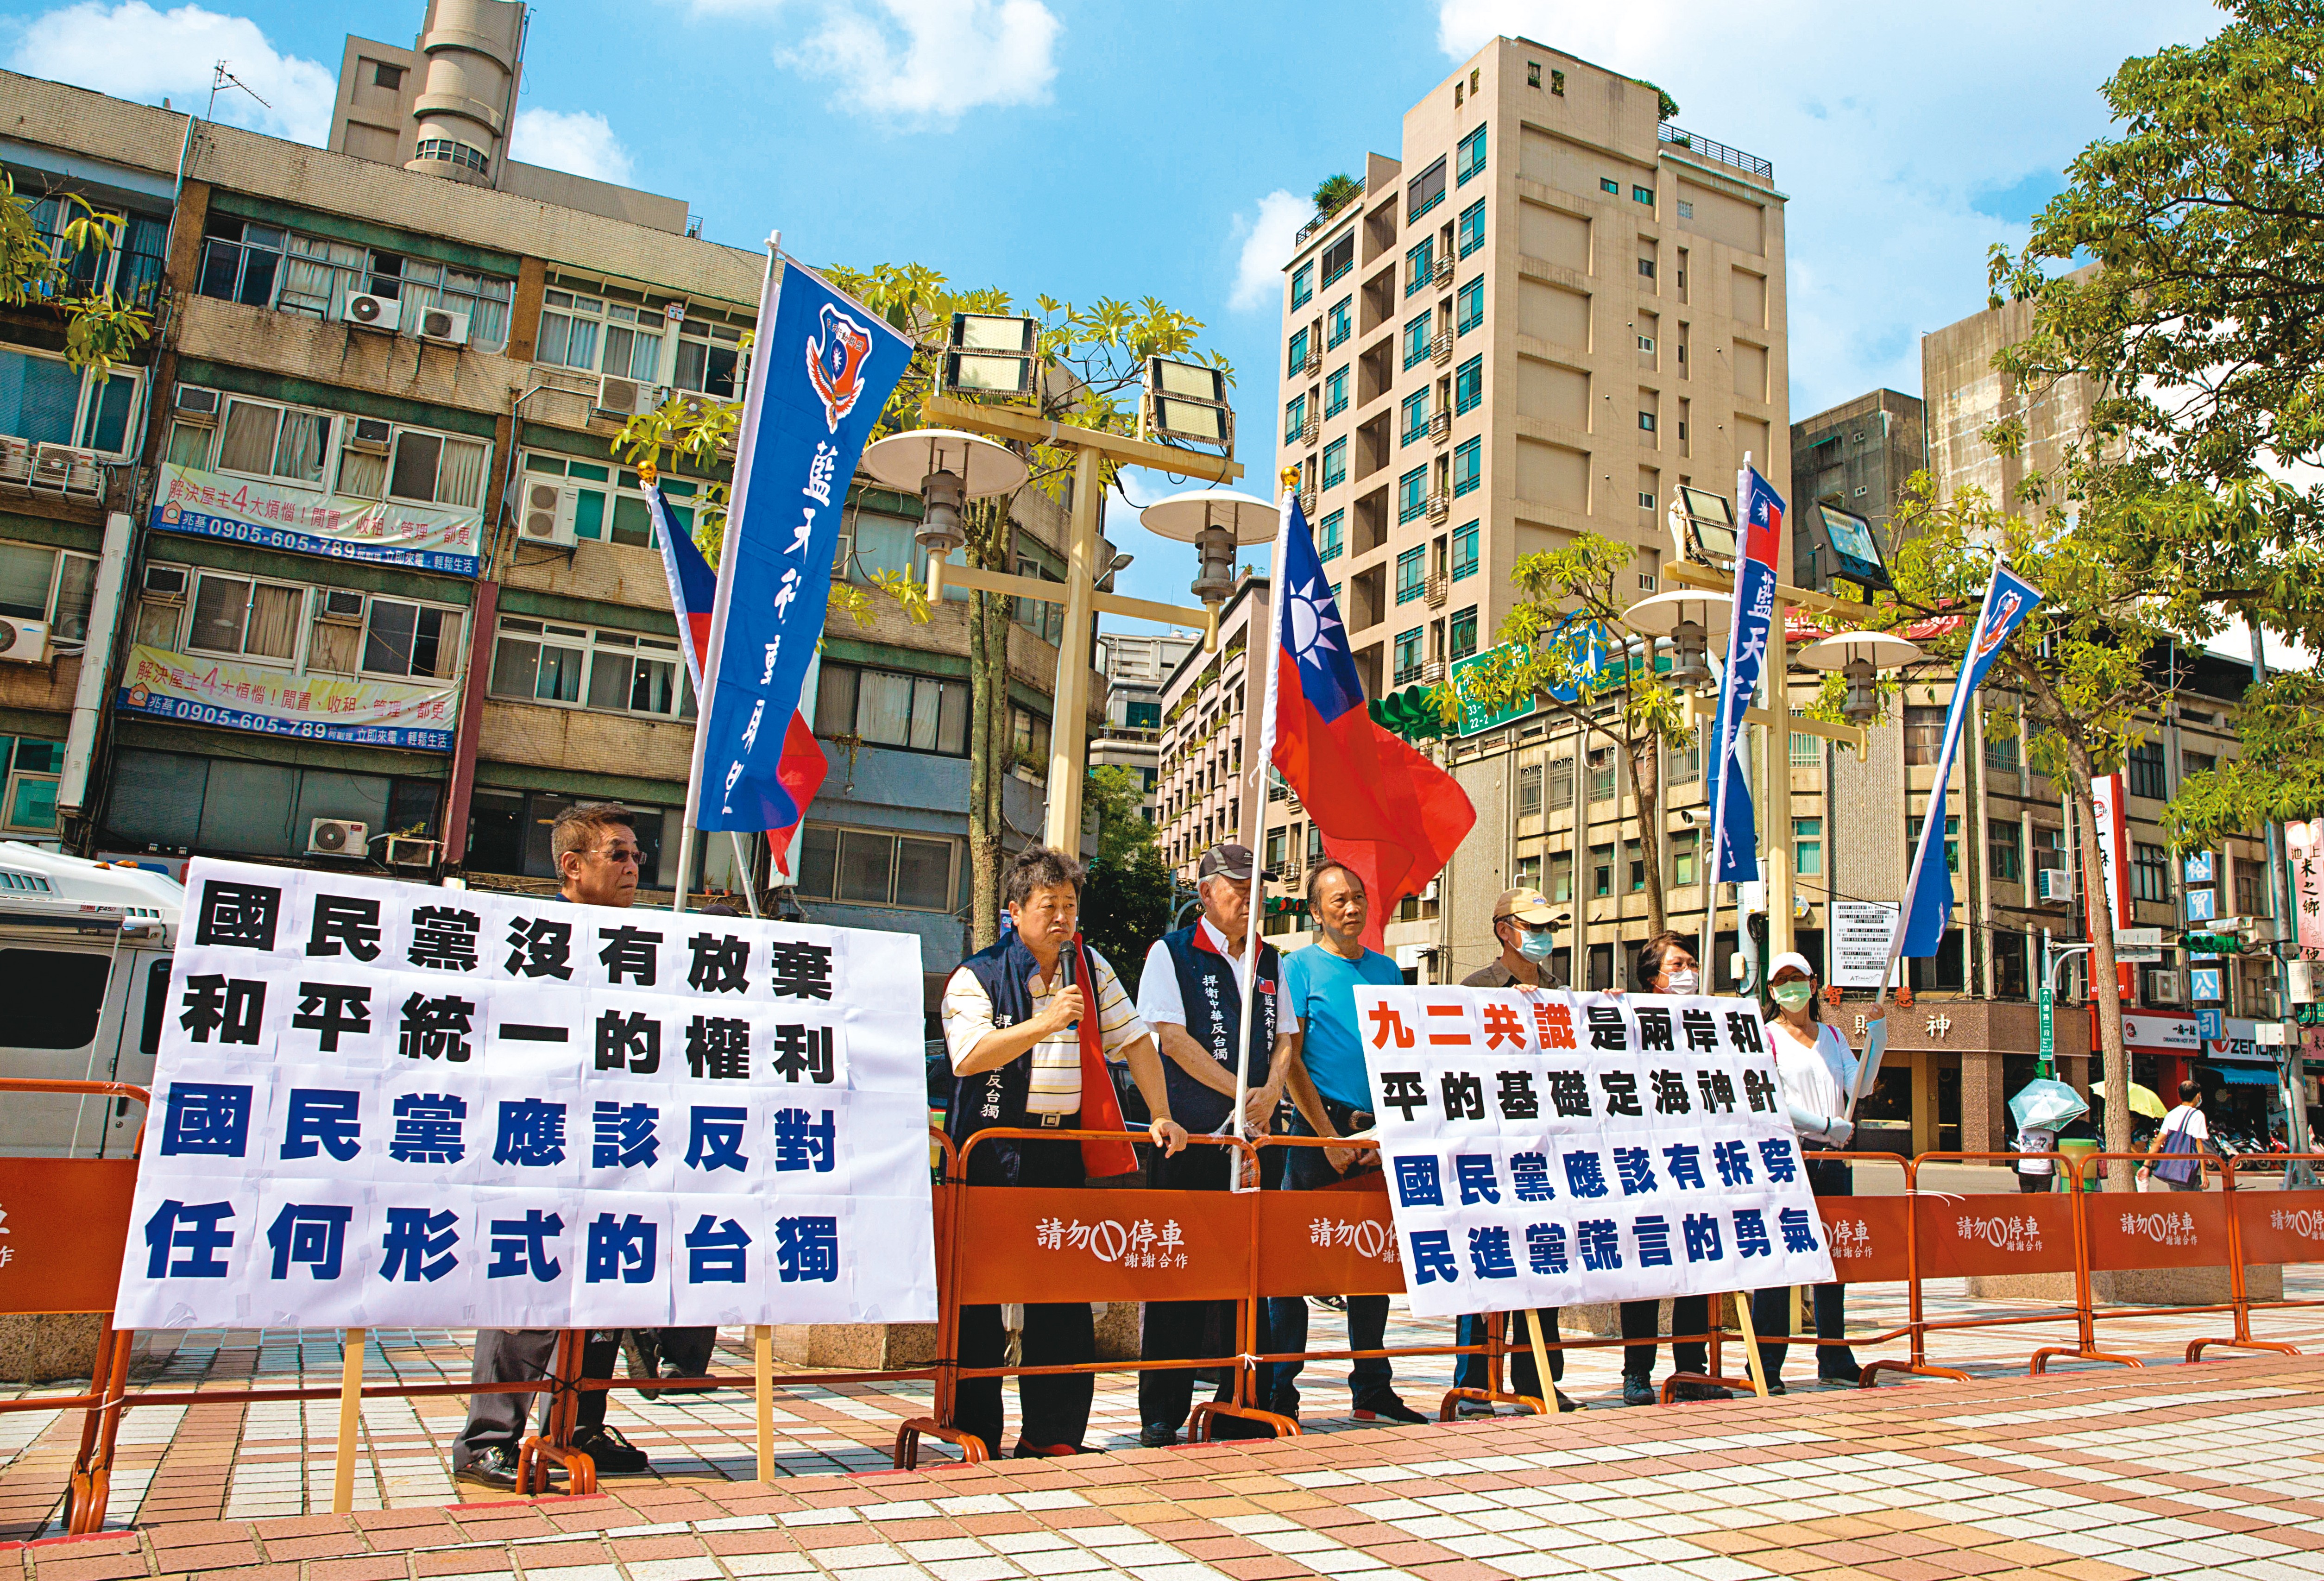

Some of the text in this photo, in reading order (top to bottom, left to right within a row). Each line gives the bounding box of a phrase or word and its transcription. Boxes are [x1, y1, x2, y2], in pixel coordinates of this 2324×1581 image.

[182, 513, 208, 529] 兆基
[209, 518, 356, 559] 0905-605-789
[149, 695, 176, 711] 兆基
[176, 701, 327, 739] 0905-605-789
[194, 879, 832, 1002] 國民黨沒有放棄
[179, 974, 834, 1084] 和平統一的權利
[1202, 975, 1228, 1060] 捍衛中華反台獨
[1369, 1001, 1763, 1054] 九二共識是兩岸和
[1380, 1069, 1777, 1121] 平的基礎定海神針
[160, 1082, 836, 1172] 國民黨應該反對
[1394, 1138, 1796, 1207] 國民黨應該有拆穿
[145, 1199, 838, 1284] 任何形式的台獨
[1410, 1207, 1818, 1285] 民進黨謊言的勇氣
[1832, 1246, 1873, 1259] 謝謝合作
[1833, 1219, 1870, 1247] 停車
[2006, 1240, 2043, 1252] 謝謝合作
[2166, 1234, 2198, 1246] 謝謝合作
[1124, 1252, 1189, 1269] 謝謝合作
